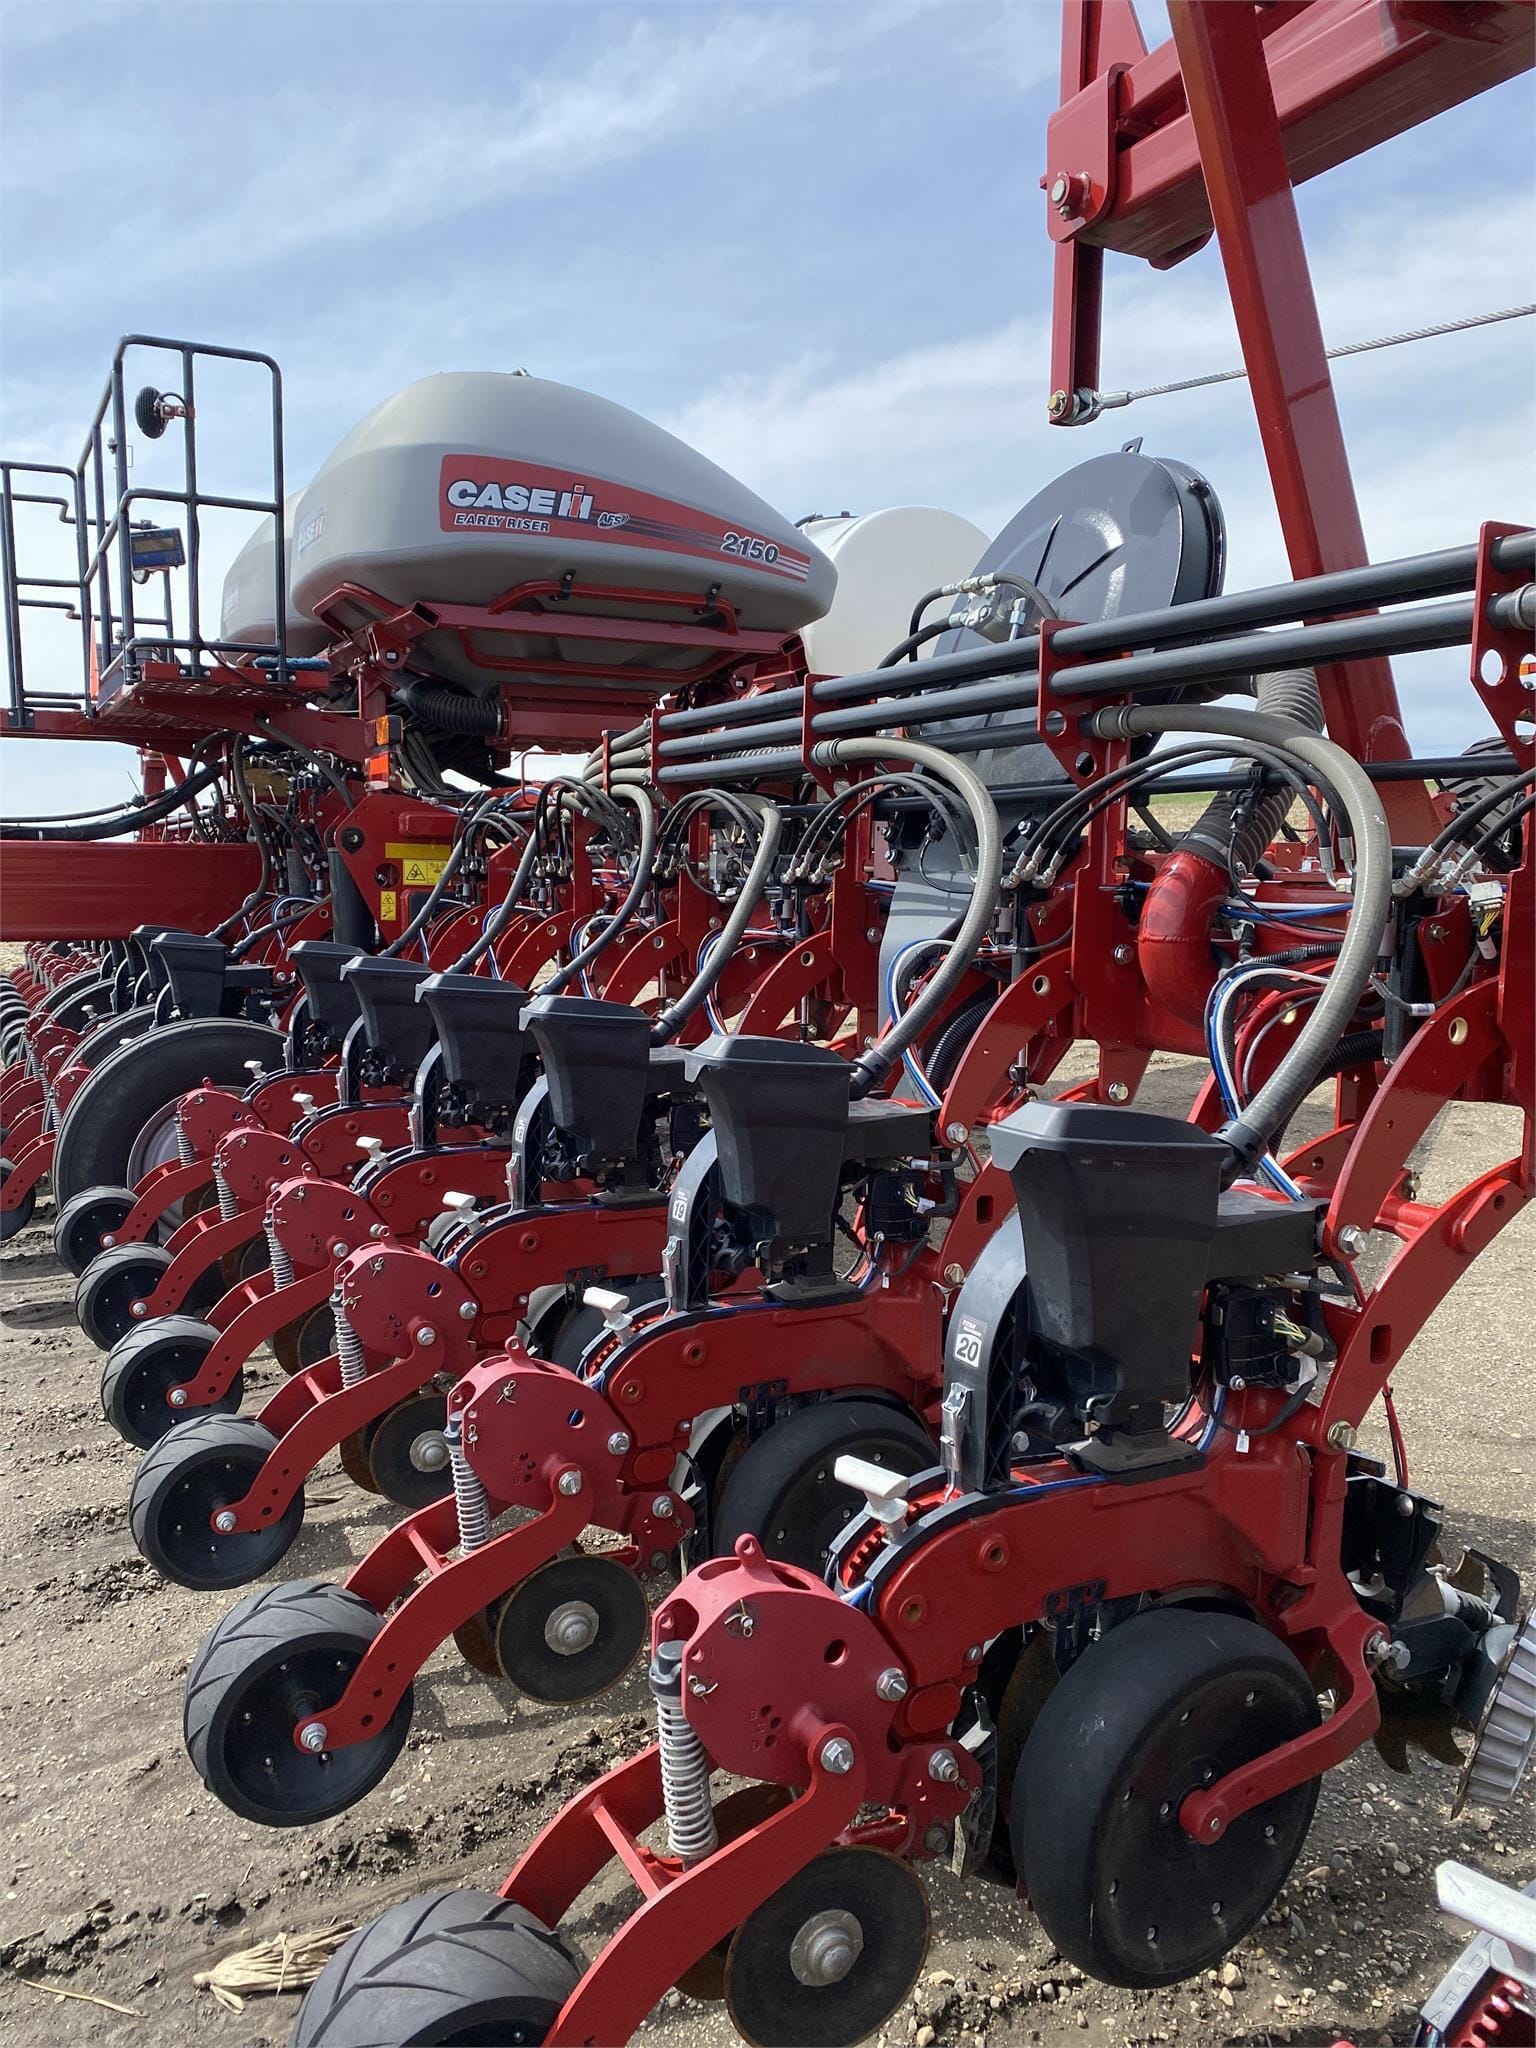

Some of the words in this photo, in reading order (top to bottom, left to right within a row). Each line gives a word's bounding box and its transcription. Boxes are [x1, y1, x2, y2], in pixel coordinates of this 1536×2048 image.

[448, 480, 557, 515] CASE
[454, 513, 504, 527] EARLY
[506, 516, 550, 532] RISER
[598, 512, 626, 528] AFS
[721, 532, 780, 564] 2150
[674, 1202, 685, 1219] 19
[956, 1336, 979, 1362] 20
